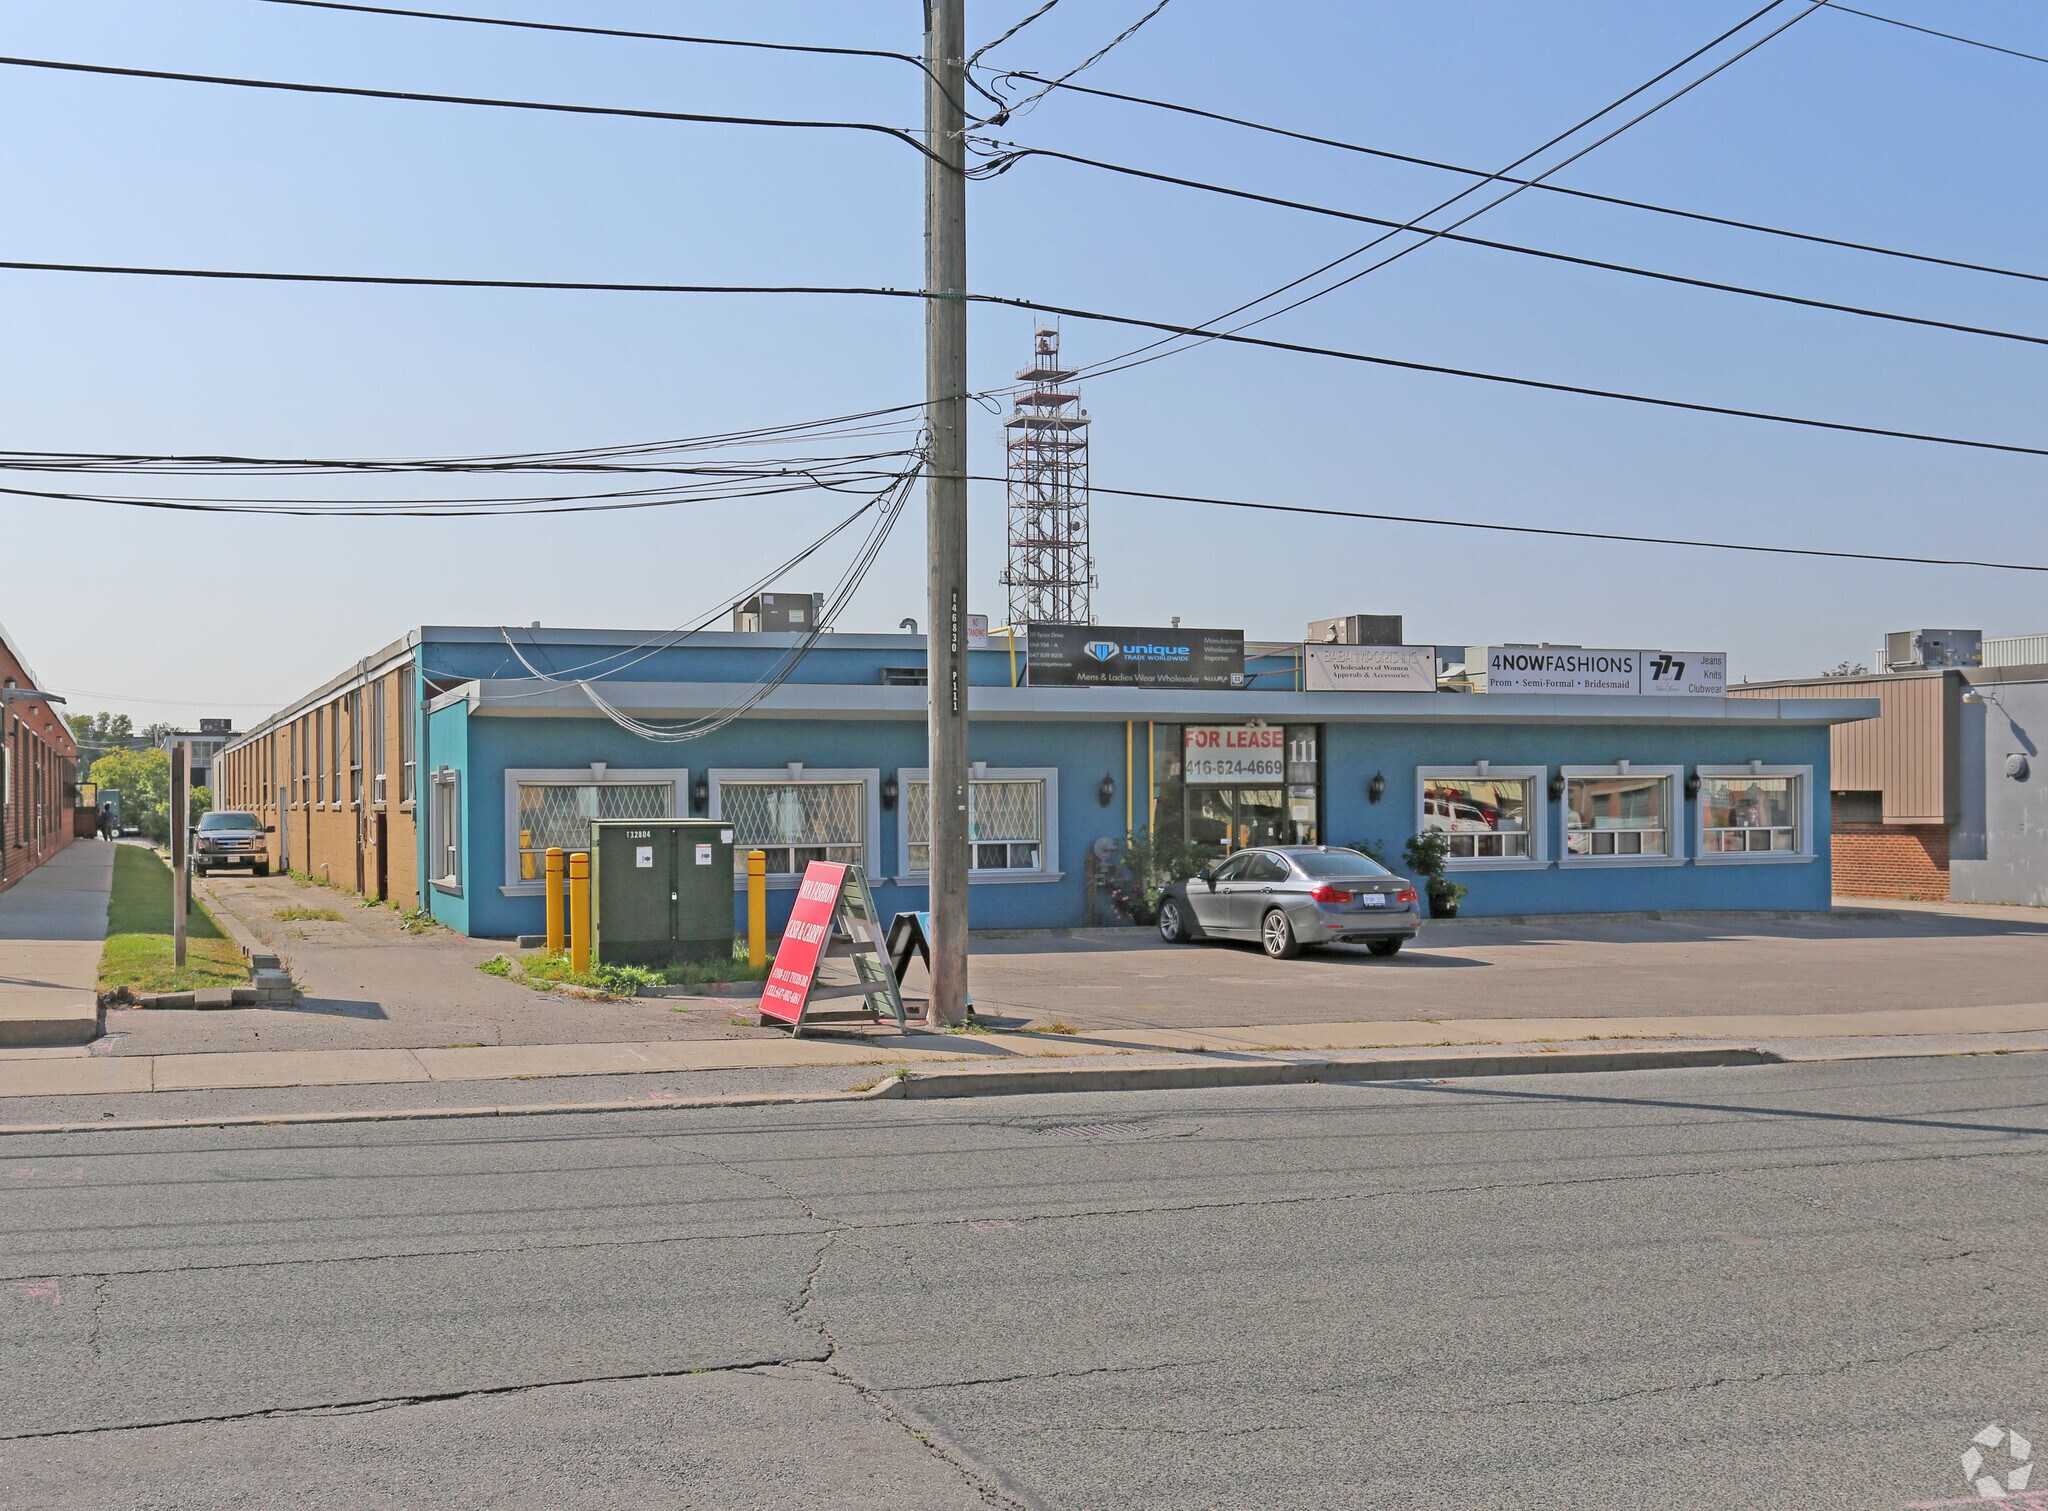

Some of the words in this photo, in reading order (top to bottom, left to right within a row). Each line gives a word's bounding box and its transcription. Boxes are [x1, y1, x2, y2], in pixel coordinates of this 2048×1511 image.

[972, 618, 979, 626] NO
[967, 628, 985, 637] TANDING
[1122, 644, 1190, 656] unique
[1323, 650, 1352, 663] BABA
[1356, 651, 1399, 664] IMPORTS
[1700, 656, 1722, 666] Jeans
[1492, 654, 1633, 673] 4NOWFASHIONS
[1077, 673, 1099, 681] Mens
[1108, 674, 1133, 682] Ladies
[1135, 674, 1156, 682] Wear
[1157, 674, 1200, 683] Wholesaler
[1704, 671, 1722, 679] Knits
[1490, 678, 1512, 686] Prom
[1522, 679, 1574, 688] Semi-Formal
[1584, 680, 1630, 689] Bridesmaid
[1689, 684, 1722, 693] Clubwear
[1186, 731, 1220, 748] FOR
[1226, 731, 1283, 748] LEASE
[1289, 740, 1317, 763] 111
[1186, 760, 1282, 774] 416-624-4669
